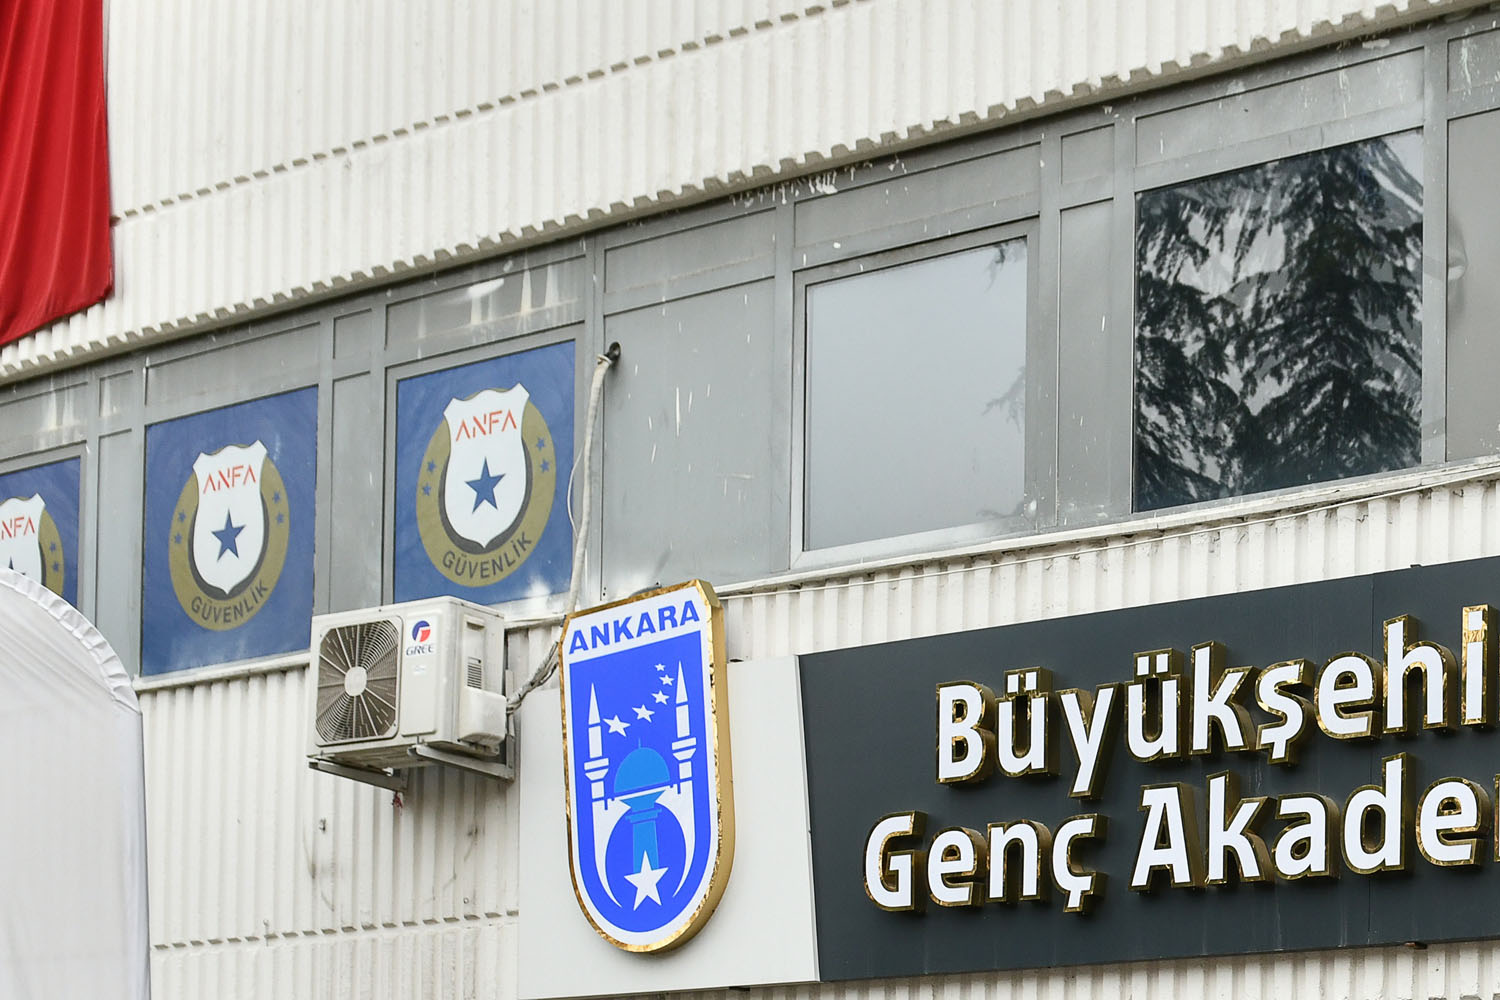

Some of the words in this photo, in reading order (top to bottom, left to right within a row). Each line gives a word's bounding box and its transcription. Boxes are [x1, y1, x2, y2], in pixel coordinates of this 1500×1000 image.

[455, 409, 517, 442] ANFA
[203, 464, 256, 495] ANFA
[1, 516, 35, 540] NFA
[442, 531, 532, 579] GÜVENLİK
[191, 580, 268, 624] GÜVENLİK
[568, 600, 700, 655] ANKARA
[863, 810, 1107, 914] Genç
